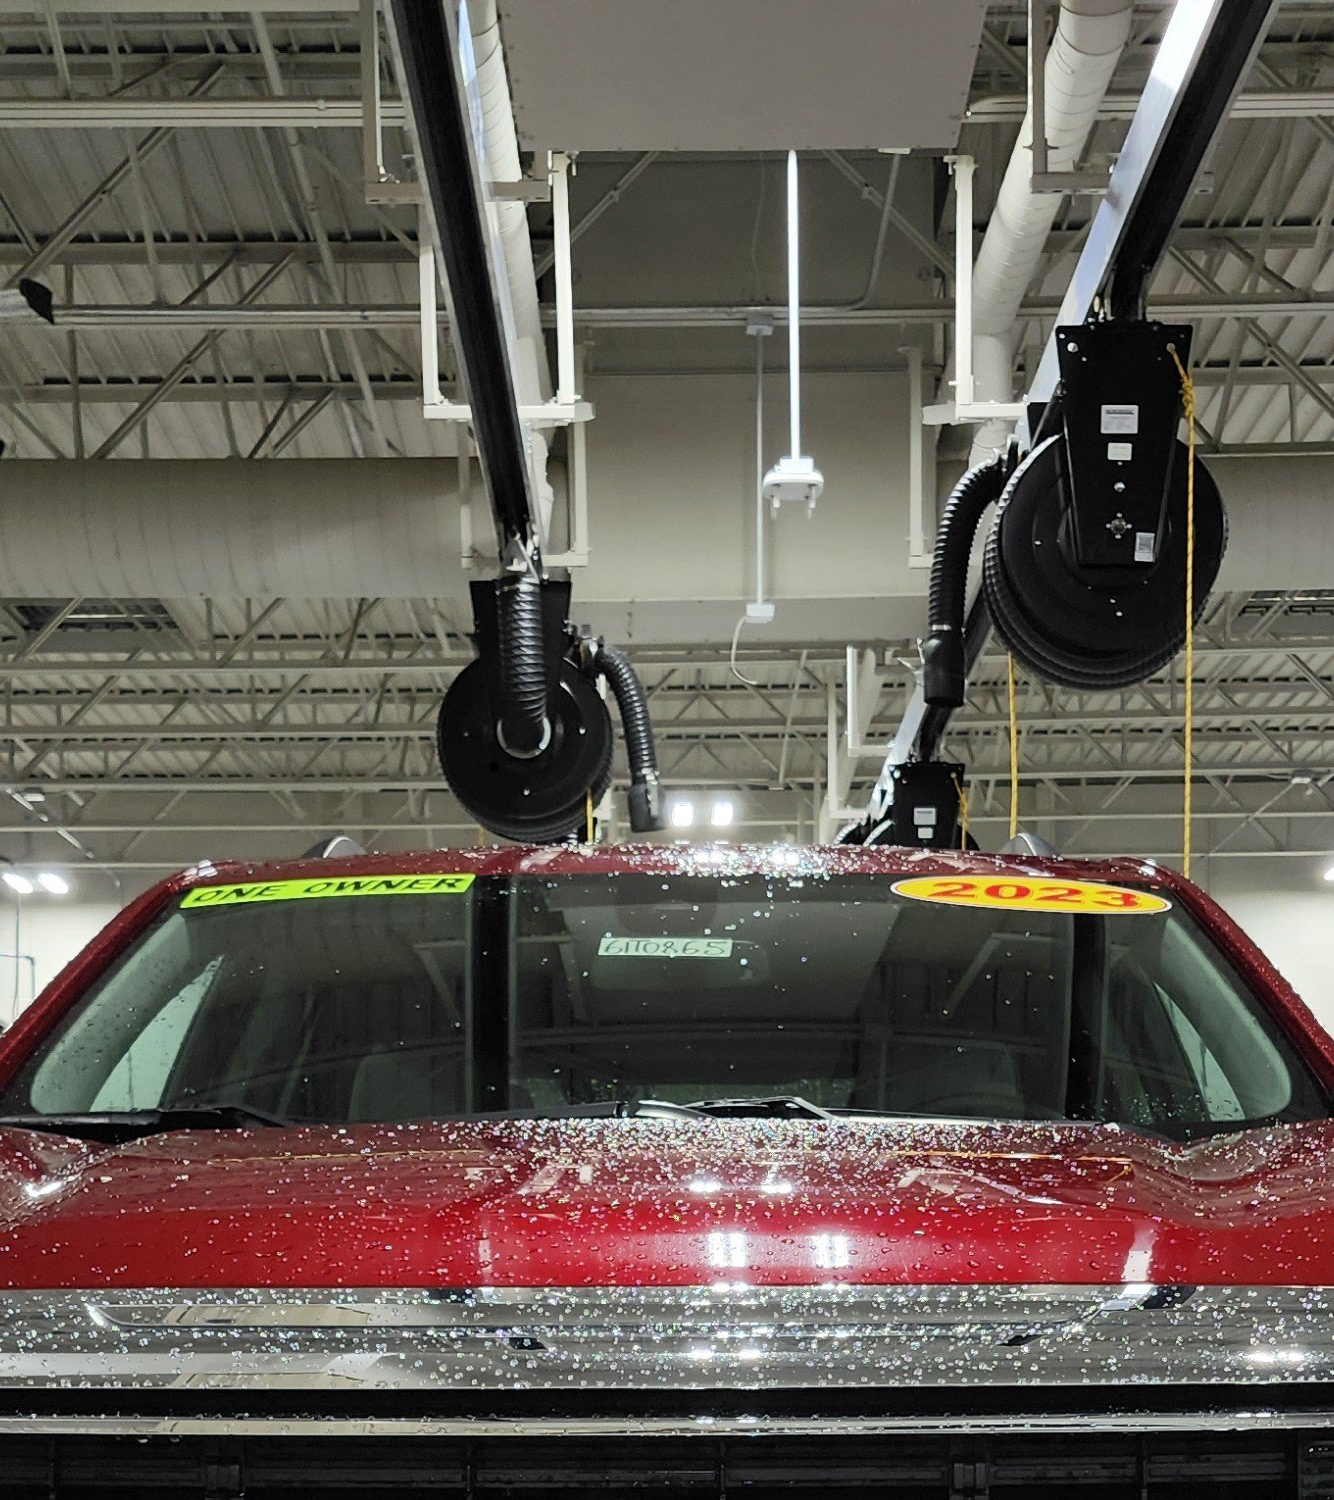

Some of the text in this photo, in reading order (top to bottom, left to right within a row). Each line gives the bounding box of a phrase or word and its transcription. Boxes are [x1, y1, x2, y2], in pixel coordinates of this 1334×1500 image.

[194, 877, 467, 903] ONE OWNER
[927, 881, 1141, 908] 2023
